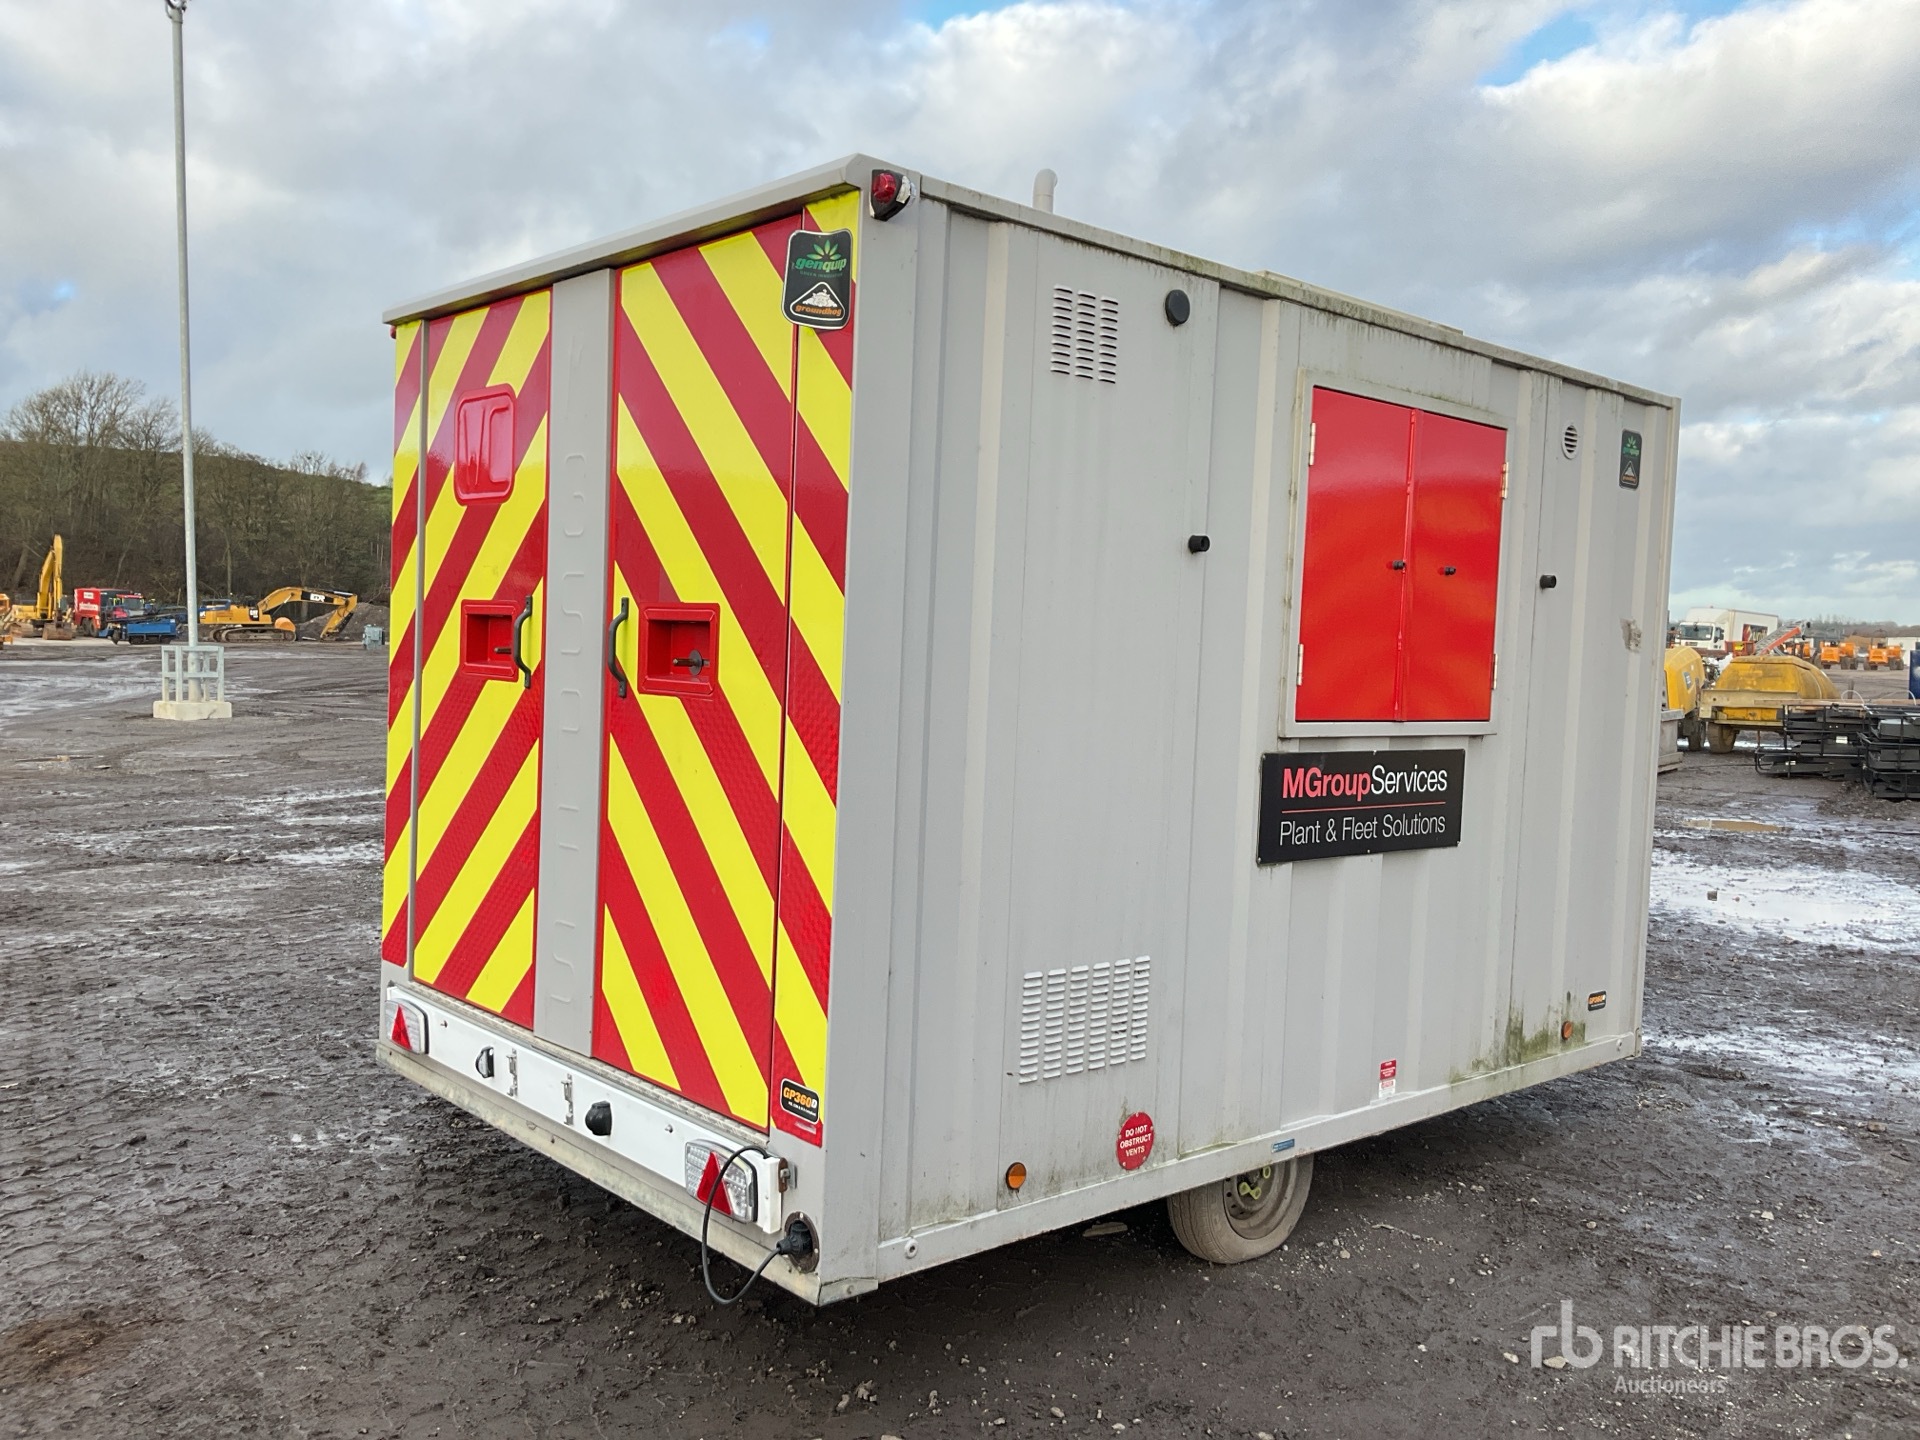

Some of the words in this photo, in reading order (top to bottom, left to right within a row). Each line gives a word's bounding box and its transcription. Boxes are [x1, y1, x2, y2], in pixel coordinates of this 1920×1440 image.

[795, 257, 847, 273] genquip
[795, 303, 842, 317] groundhog
[1279, 819, 1321, 846] Plant
[1325, 818, 1337, 842] &
[1342, 816, 1378, 841] Fleet
[1382, 812, 1446, 838] Solutions
[783, 1087, 818, 1109] GP360D
[1125, 1129, 1134, 1138] DO
[1135, 1125, 1147, 1135] NOT
[1120, 1133, 1151, 1149] OBSTRUCT
[1126, 1146, 1145, 1157] VENTS
